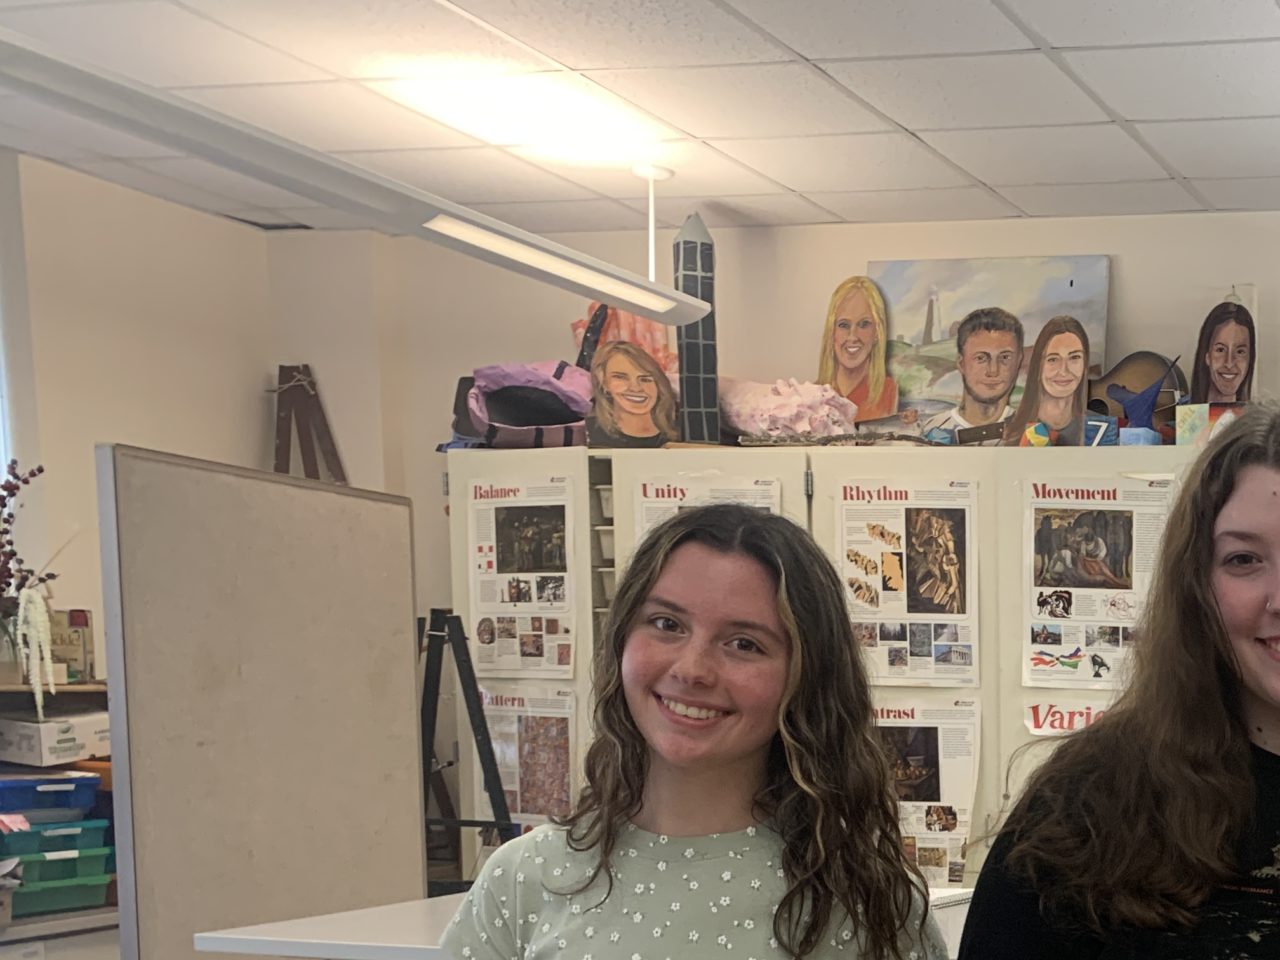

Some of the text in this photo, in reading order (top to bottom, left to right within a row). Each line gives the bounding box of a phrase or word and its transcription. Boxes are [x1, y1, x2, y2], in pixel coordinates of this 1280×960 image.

[473, 484, 520, 500] Balance
[641, 482, 689, 502] Unity
[842, 485, 909, 504] Rhythm
[1031, 483, 1118, 501] Movement
